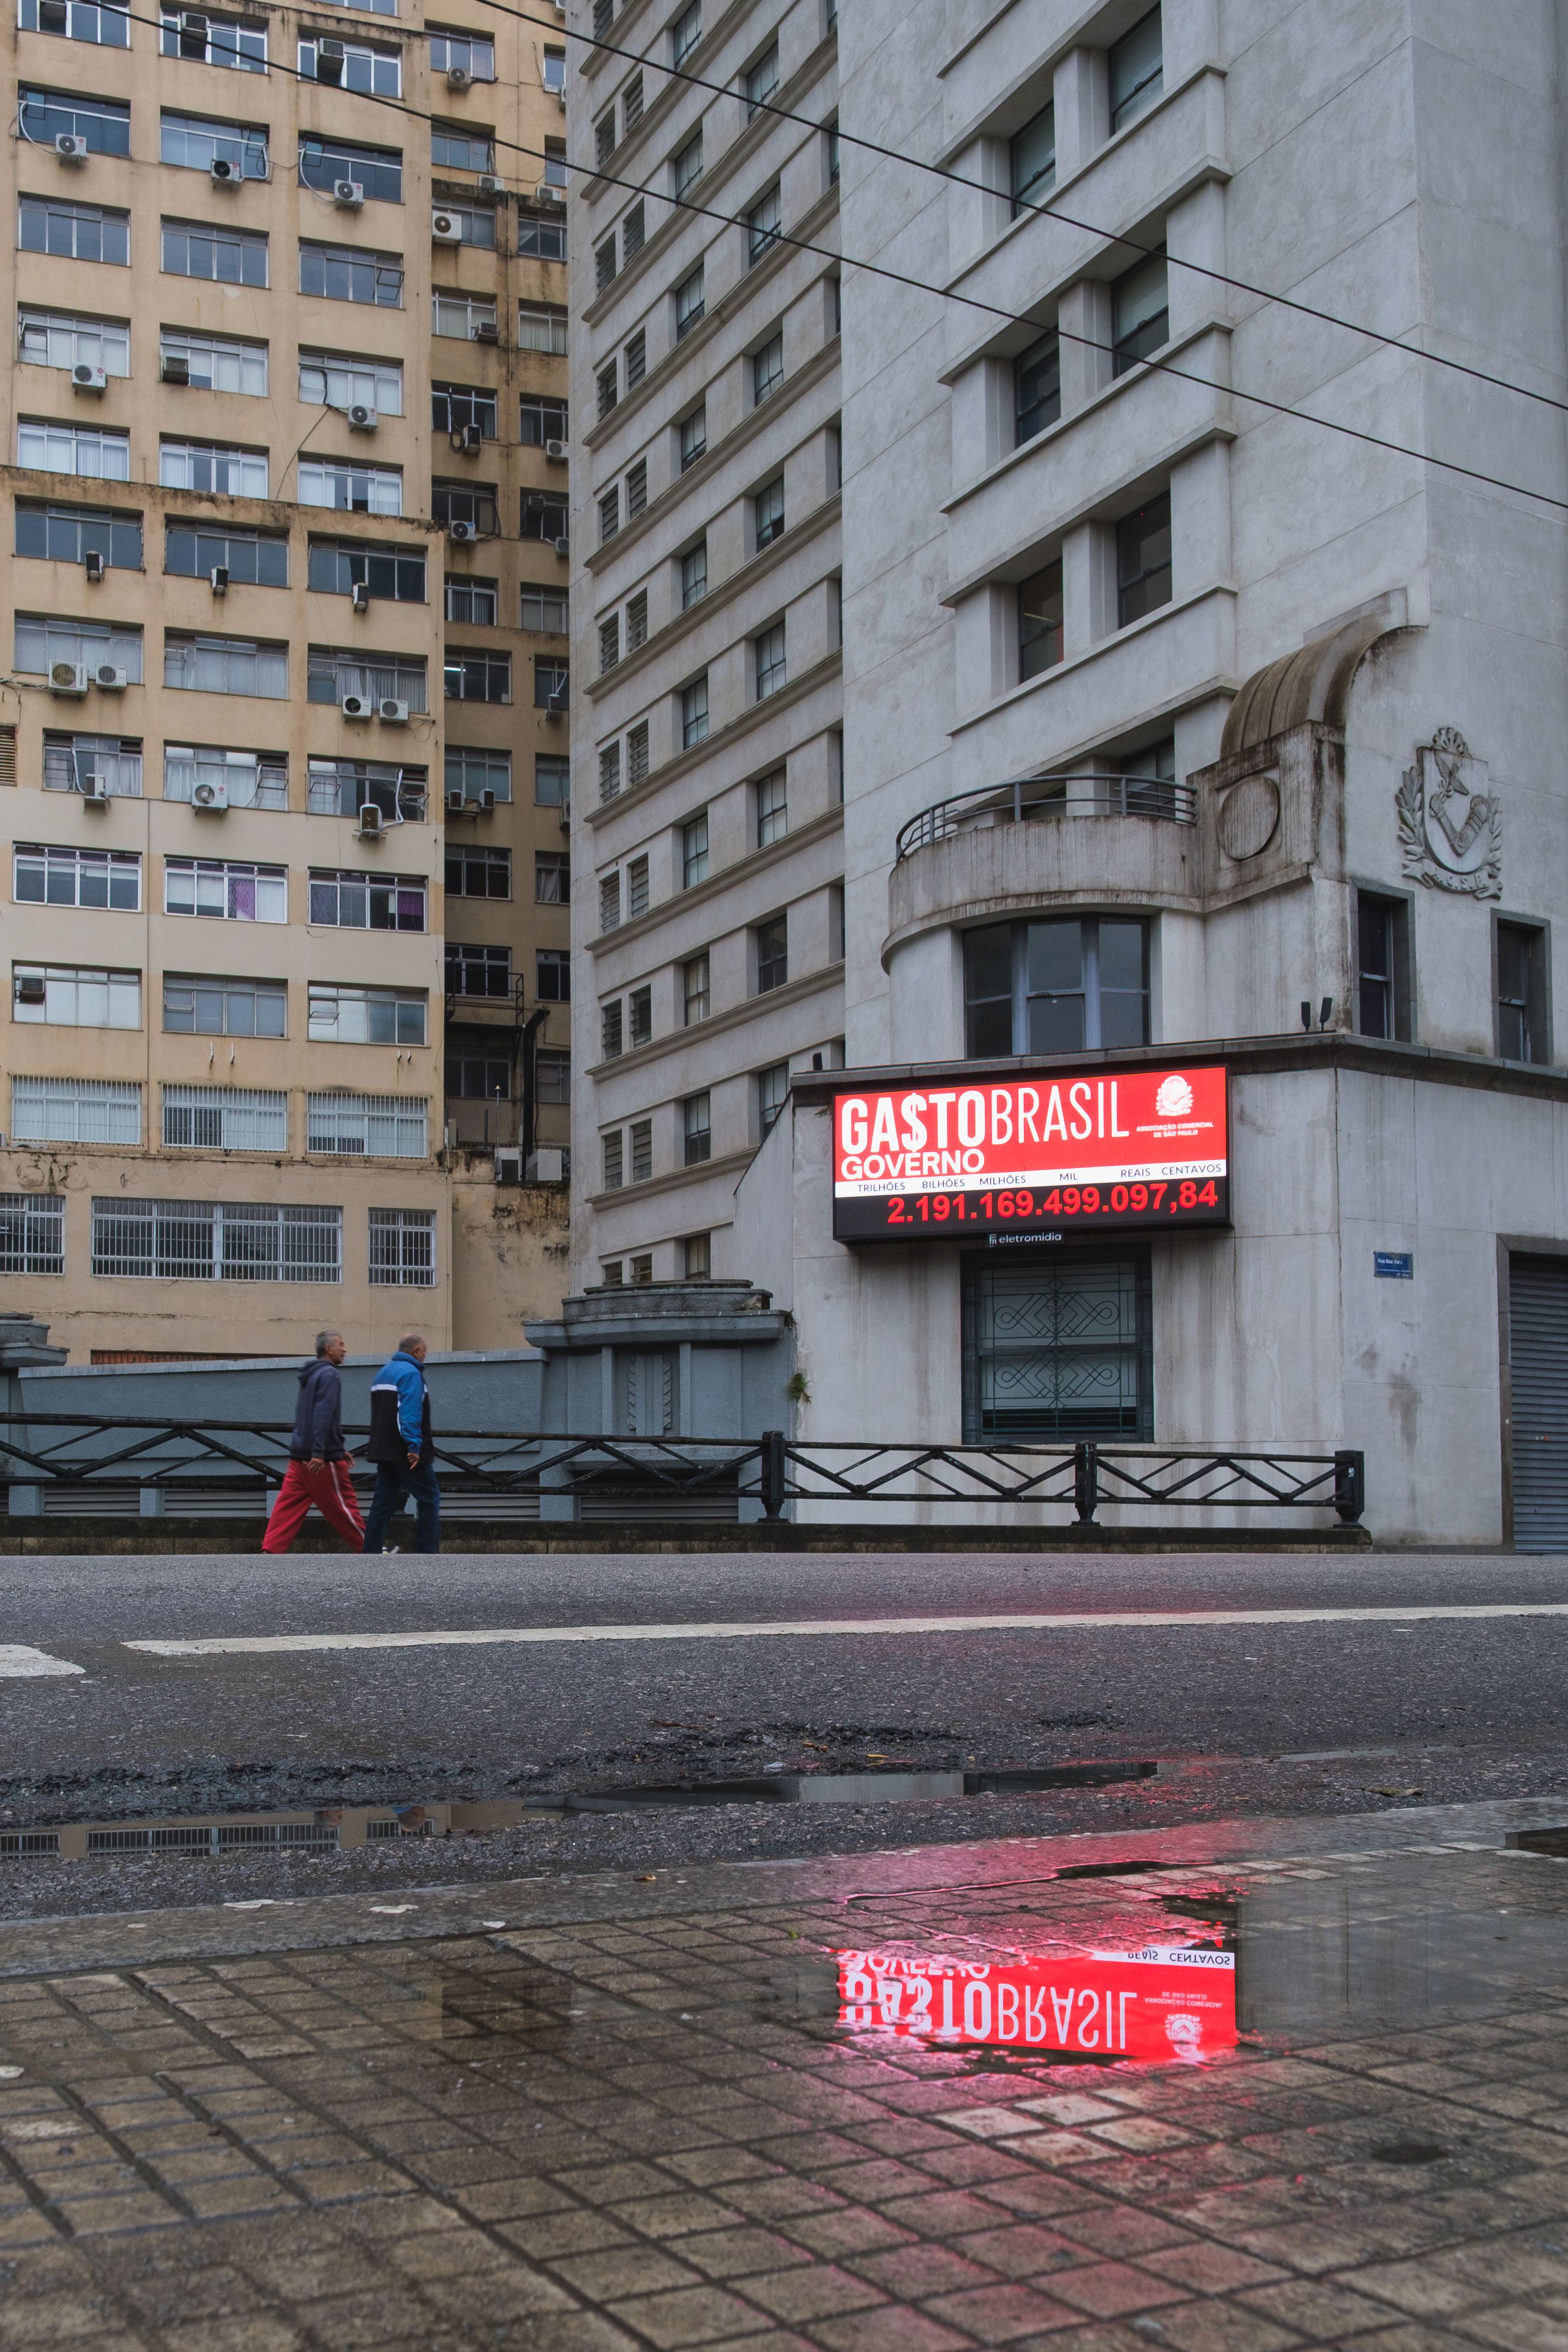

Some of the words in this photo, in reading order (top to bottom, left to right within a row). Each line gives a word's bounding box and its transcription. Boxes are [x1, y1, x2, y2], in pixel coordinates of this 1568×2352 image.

[1177, 1121, 1214, 1130] COMERCIAL
[841, 1148, 985, 1180] GOVERNO
[858, 1181, 906, 1192] TRILHÕES
[922, 1177, 965, 1189] BILHÕES
[979, 1175, 1027, 1186] MILHÕES
[1060, 1173, 1078, 1181] MIL
[1120, 1168, 1151, 1177] REAIS
[1161, 1163, 1222, 1176] CENTAVOS
[888, 1180, 1218, 1224] 2.191.169.499.097,84
[999, 1232, 1062, 1243] eletromidia
